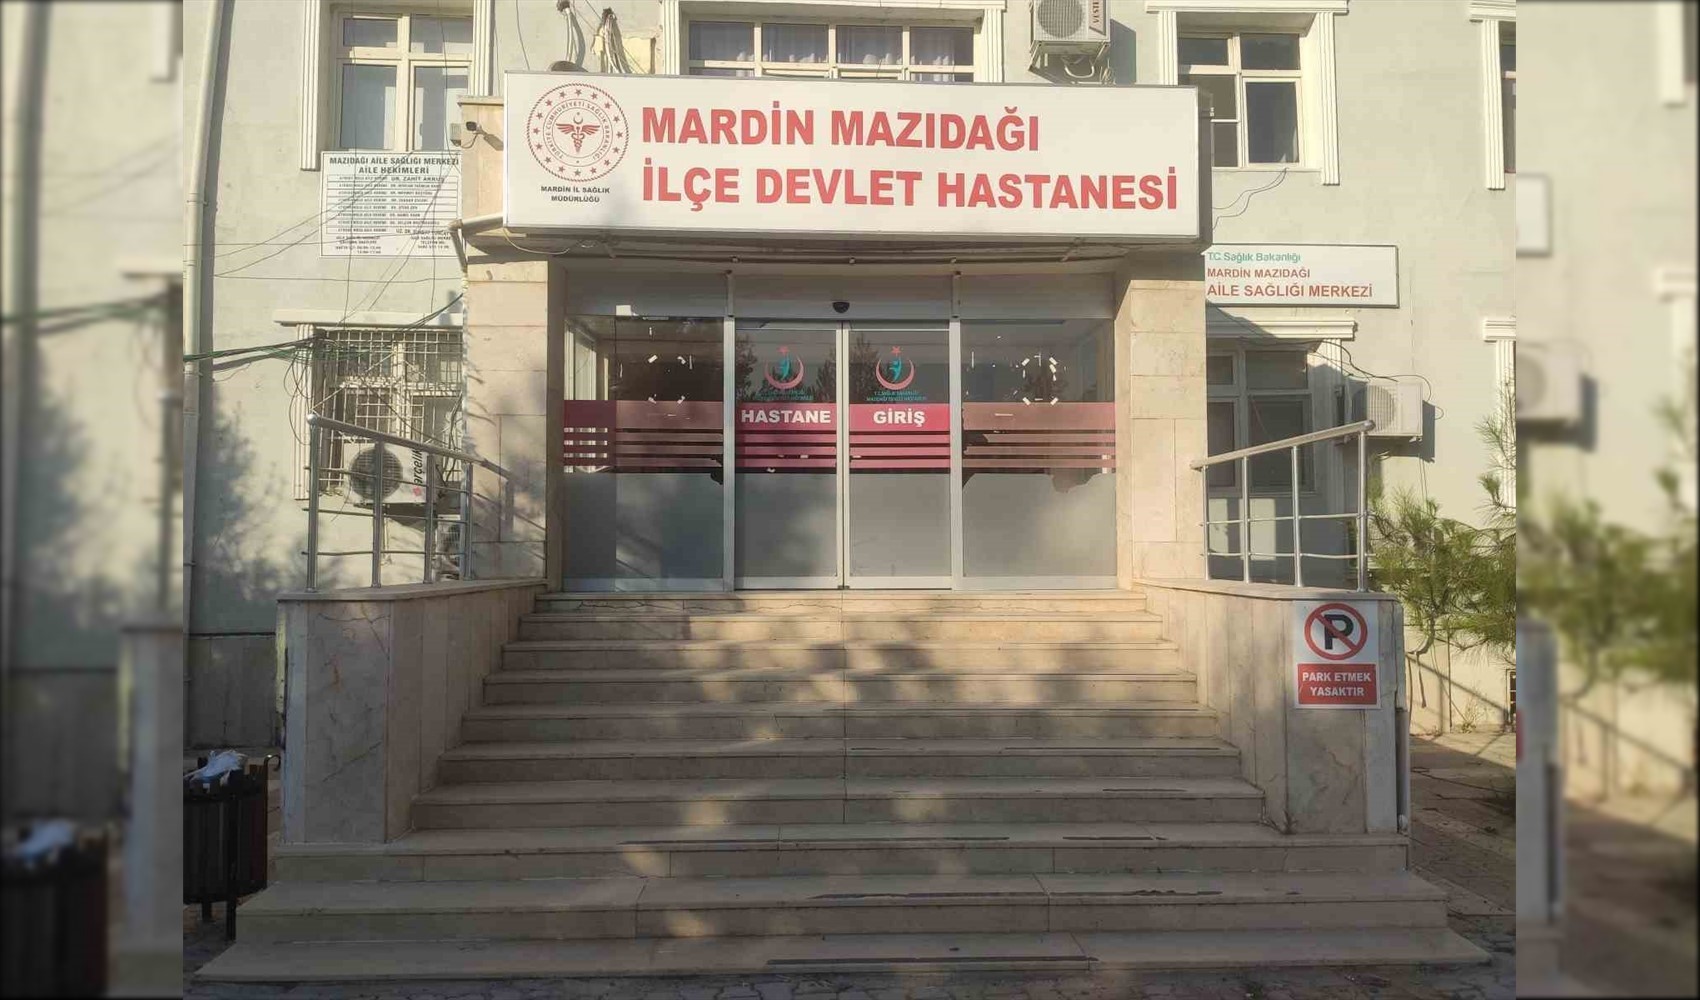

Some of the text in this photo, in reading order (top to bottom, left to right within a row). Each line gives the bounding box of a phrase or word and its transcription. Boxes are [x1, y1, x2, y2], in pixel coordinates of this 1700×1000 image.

[642, 100, 1039, 151] MARDİN MAZIDAĞI
[371, 156, 389, 165] AİLE
[358, 166, 378, 174] AİLE
[541, 185, 610, 194] MARDİN İL SAĞLIK
[643, 157, 1177, 212] İLÇE DEVLET HASTANESİ
[551, 194, 600, 203] MÜDÜRLÜĞÜ
[1224, 252, 1253, 264] Sağlık
[1256, 252, 1301, 264] Bakanlığı
[1207, 268, 1310, 279] MARDİN MAZIDAĞI
[1207, 283, 1373, 298] AİLE SAĞLIĞI MERKEZİ
[741, 408, 925, 427] HASTANE GİRİŞ
[1302, 672, 1371, 682] PARK ETMEK
[1310, 686, 1364, 697] YASAKTIR
